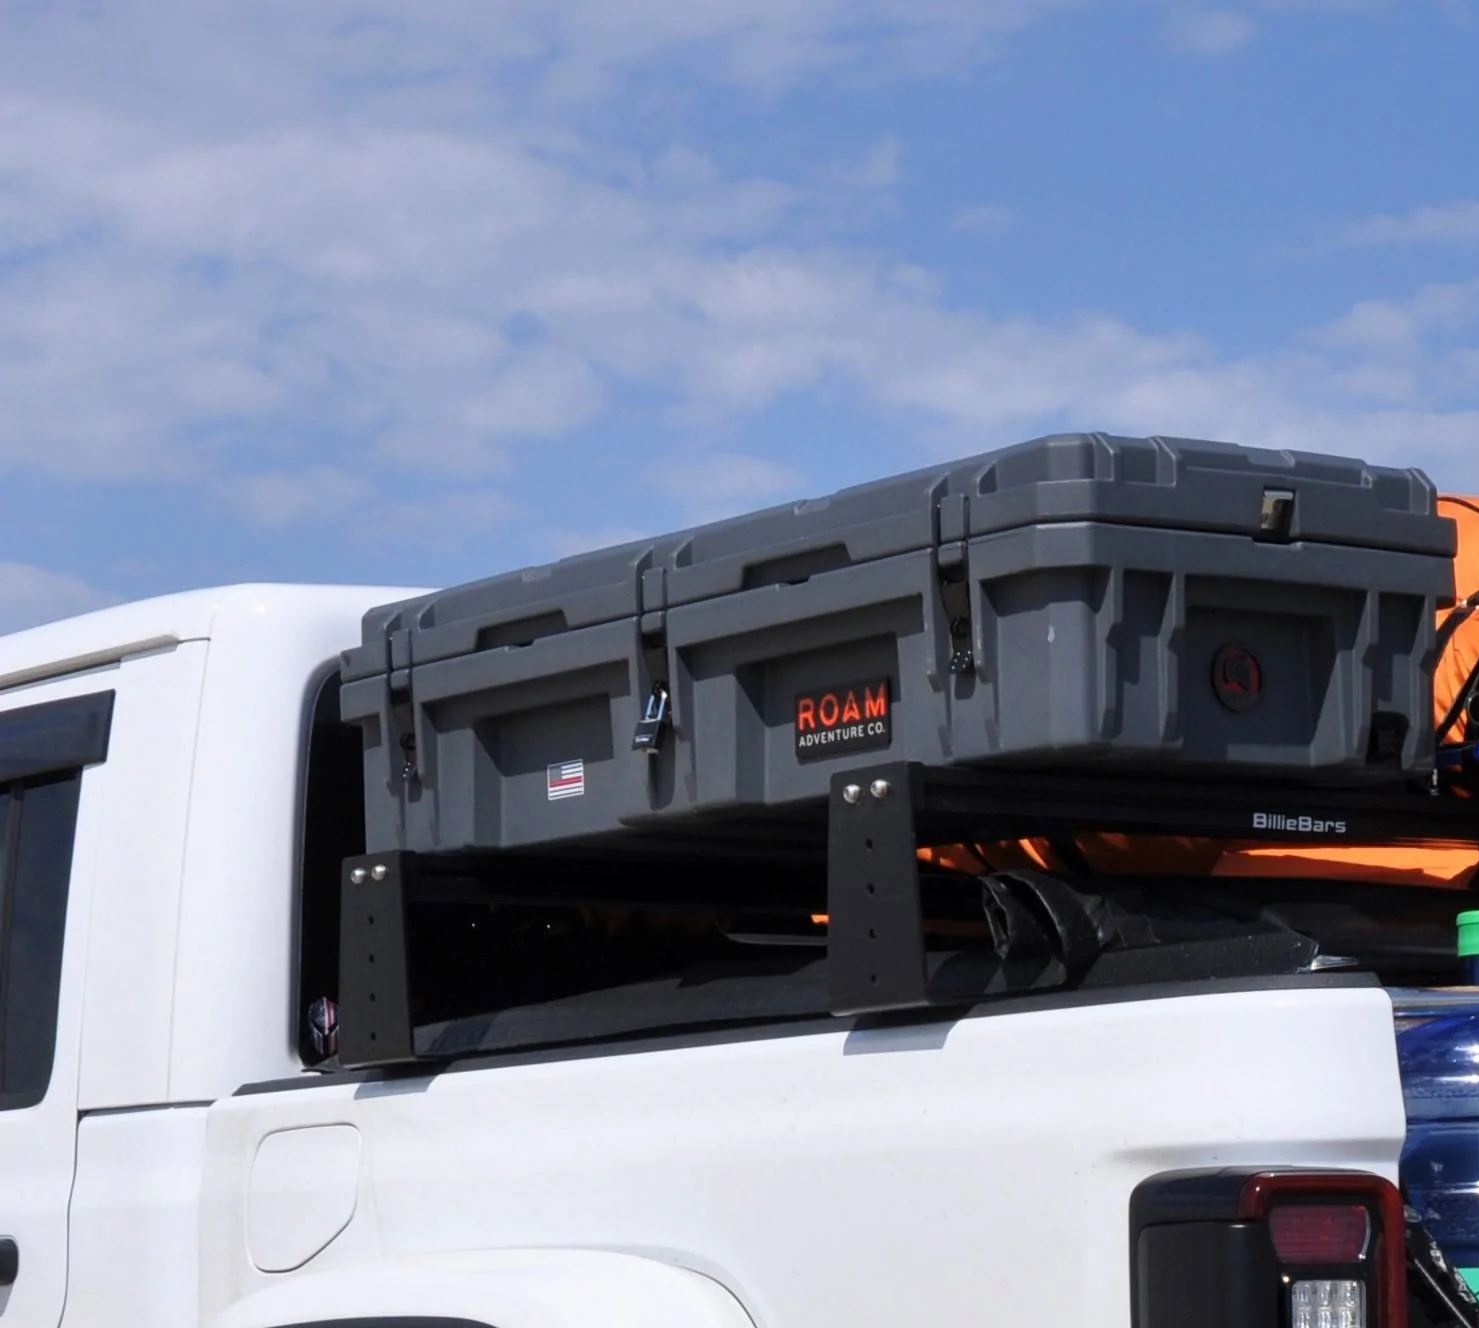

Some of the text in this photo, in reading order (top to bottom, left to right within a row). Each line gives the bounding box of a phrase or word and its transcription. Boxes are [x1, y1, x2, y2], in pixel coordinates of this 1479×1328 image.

[798, 684, 887, 731] ROAM
[798, 720, 886, 748] ADVENTURE CO.
[1252, 812, 1346, 833] BillieBars
